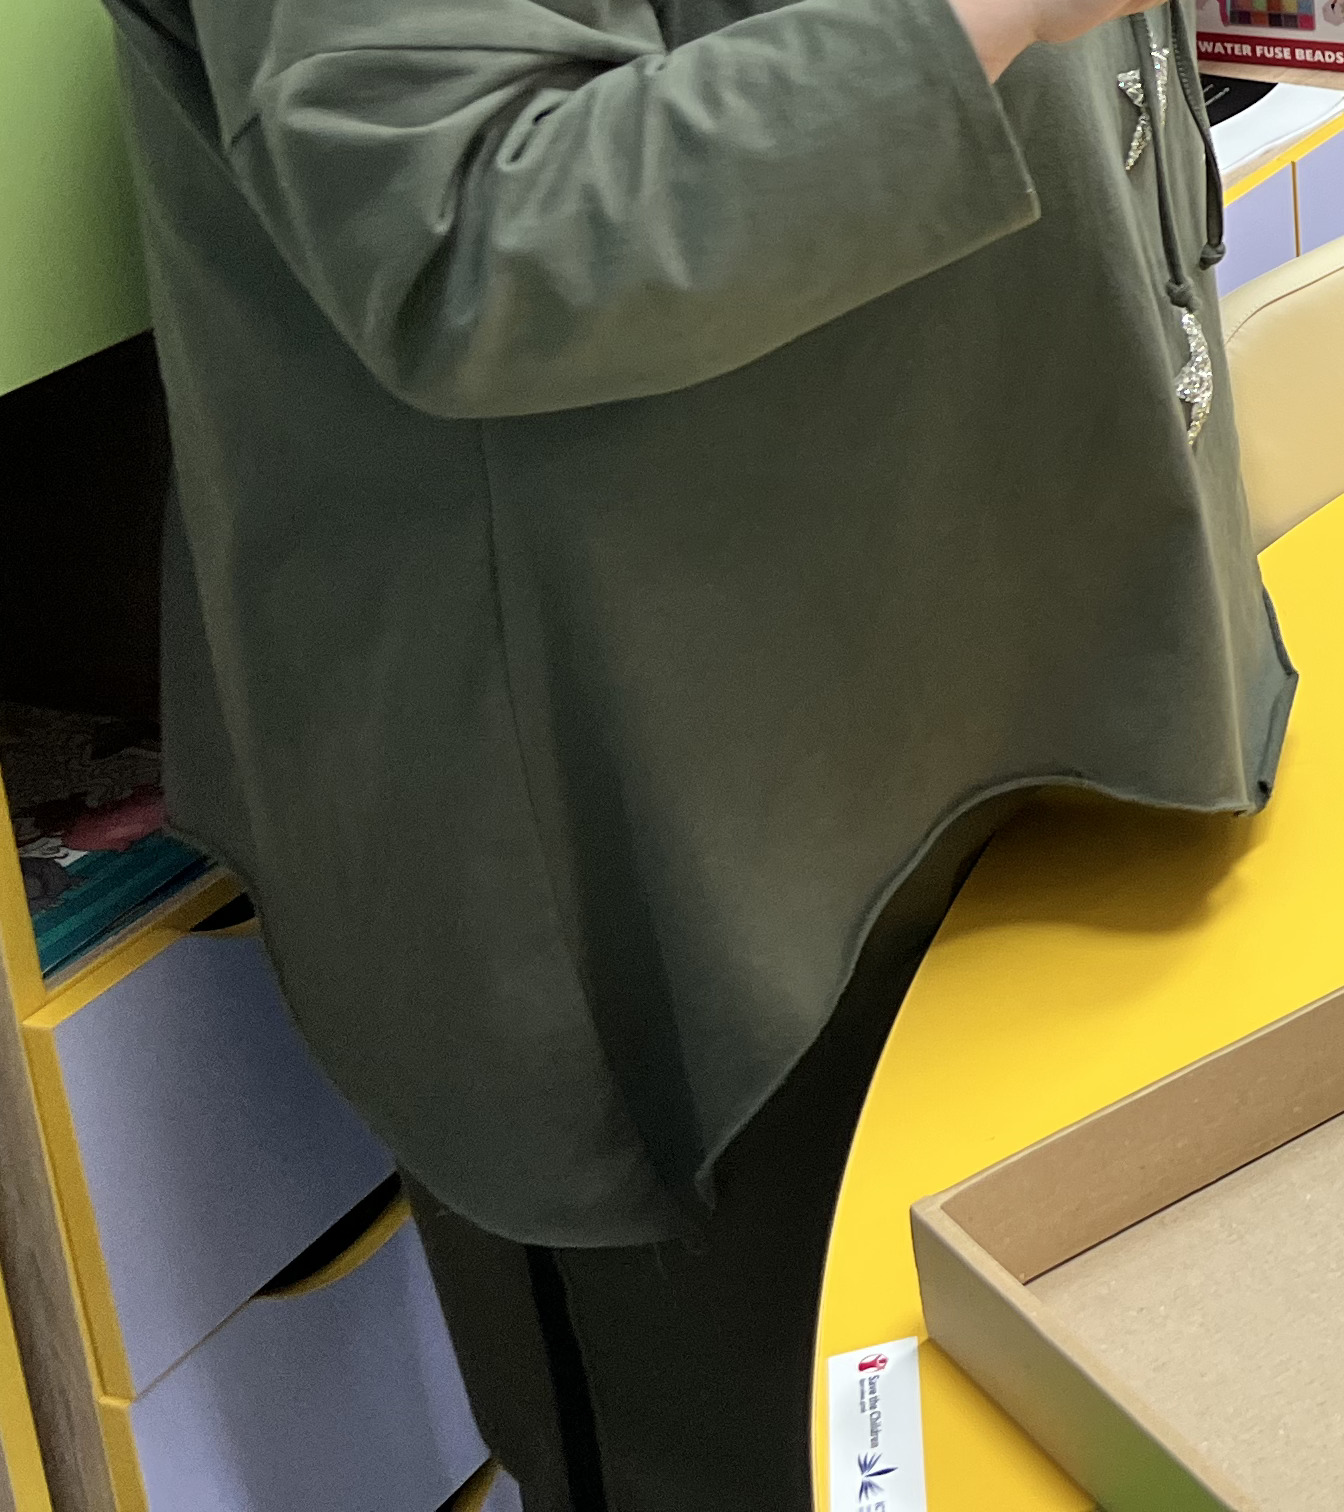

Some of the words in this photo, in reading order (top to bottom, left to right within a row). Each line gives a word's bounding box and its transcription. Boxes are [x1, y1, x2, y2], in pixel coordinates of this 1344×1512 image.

[1198, 41, 1252, 56] WATER
[1256, 45, 1292, 60] FUSE
[1295, 48, 1344, 64] BEADS
[868, 1374, 880, 1396] Save
[868, 1396, 881, 1411] the
[869, 1410, 882, 1449] Children
